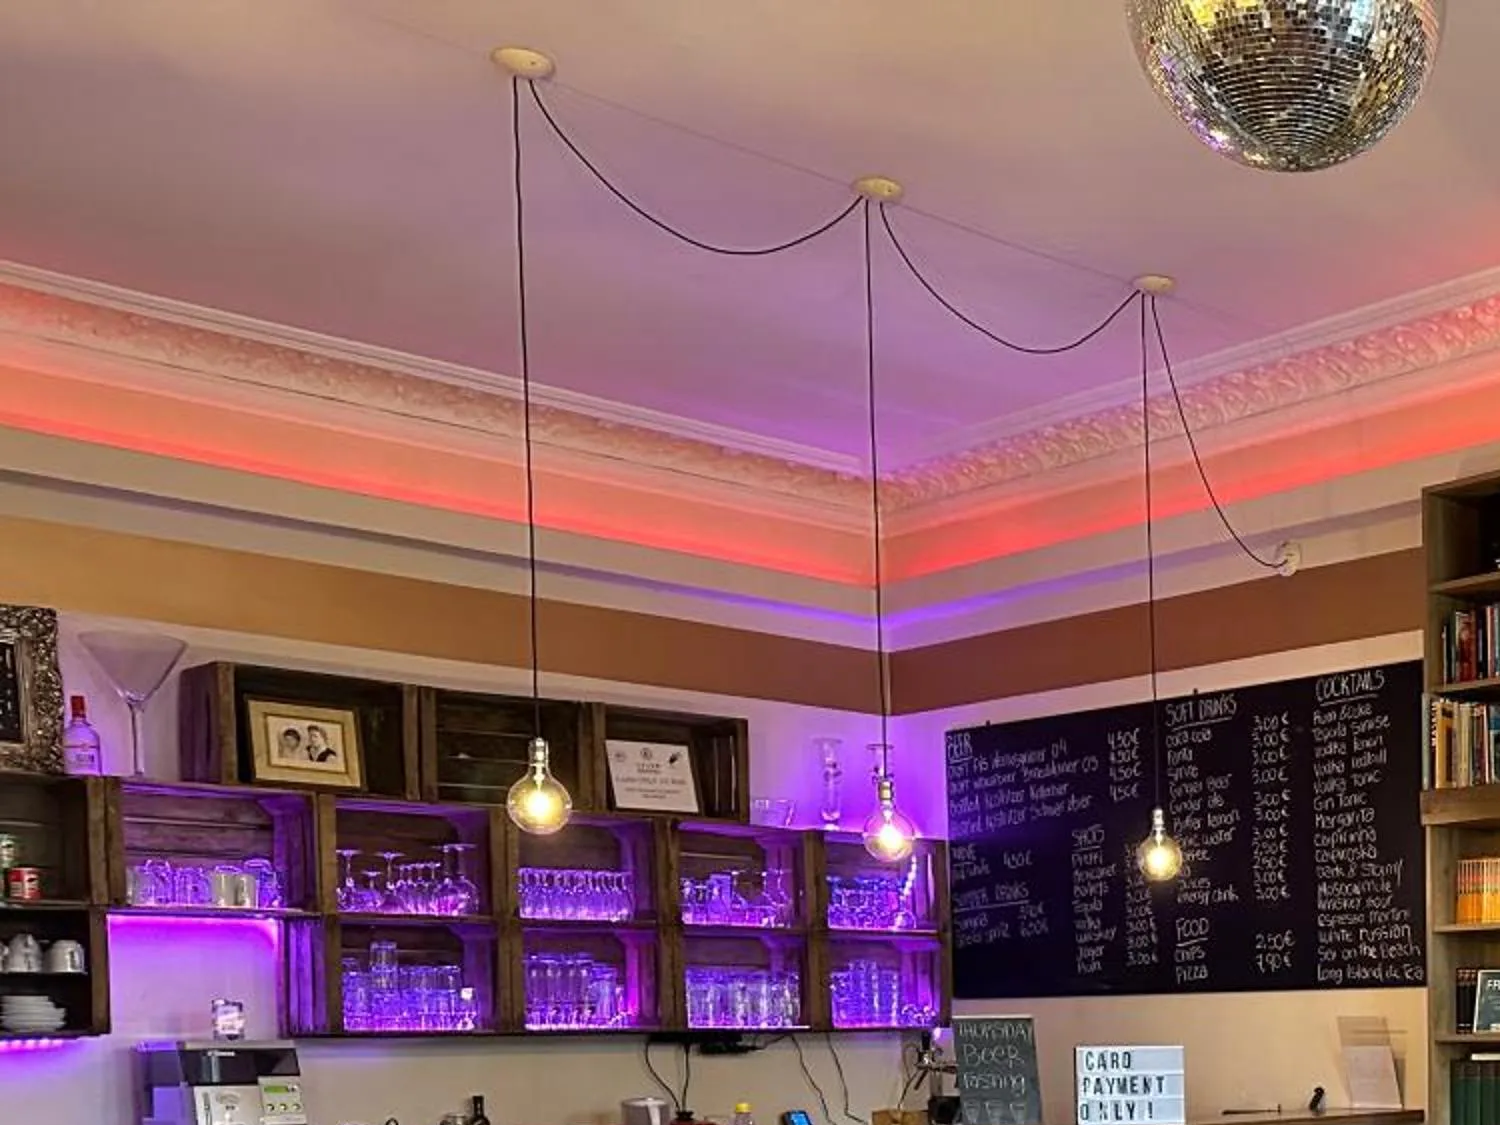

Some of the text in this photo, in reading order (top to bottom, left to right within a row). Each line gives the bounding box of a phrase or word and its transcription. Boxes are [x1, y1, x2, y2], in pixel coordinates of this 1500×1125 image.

[1316, 670, 1385, 701] COCKTAILS
[1165, 693, 1237, 726] SOFT DRINKS
[1175, 917, 1209, 940] FOOD
[1085, 1051, 1132, 1072] CARD
[1083, 1076, 1165, 1096] PAYMENT
